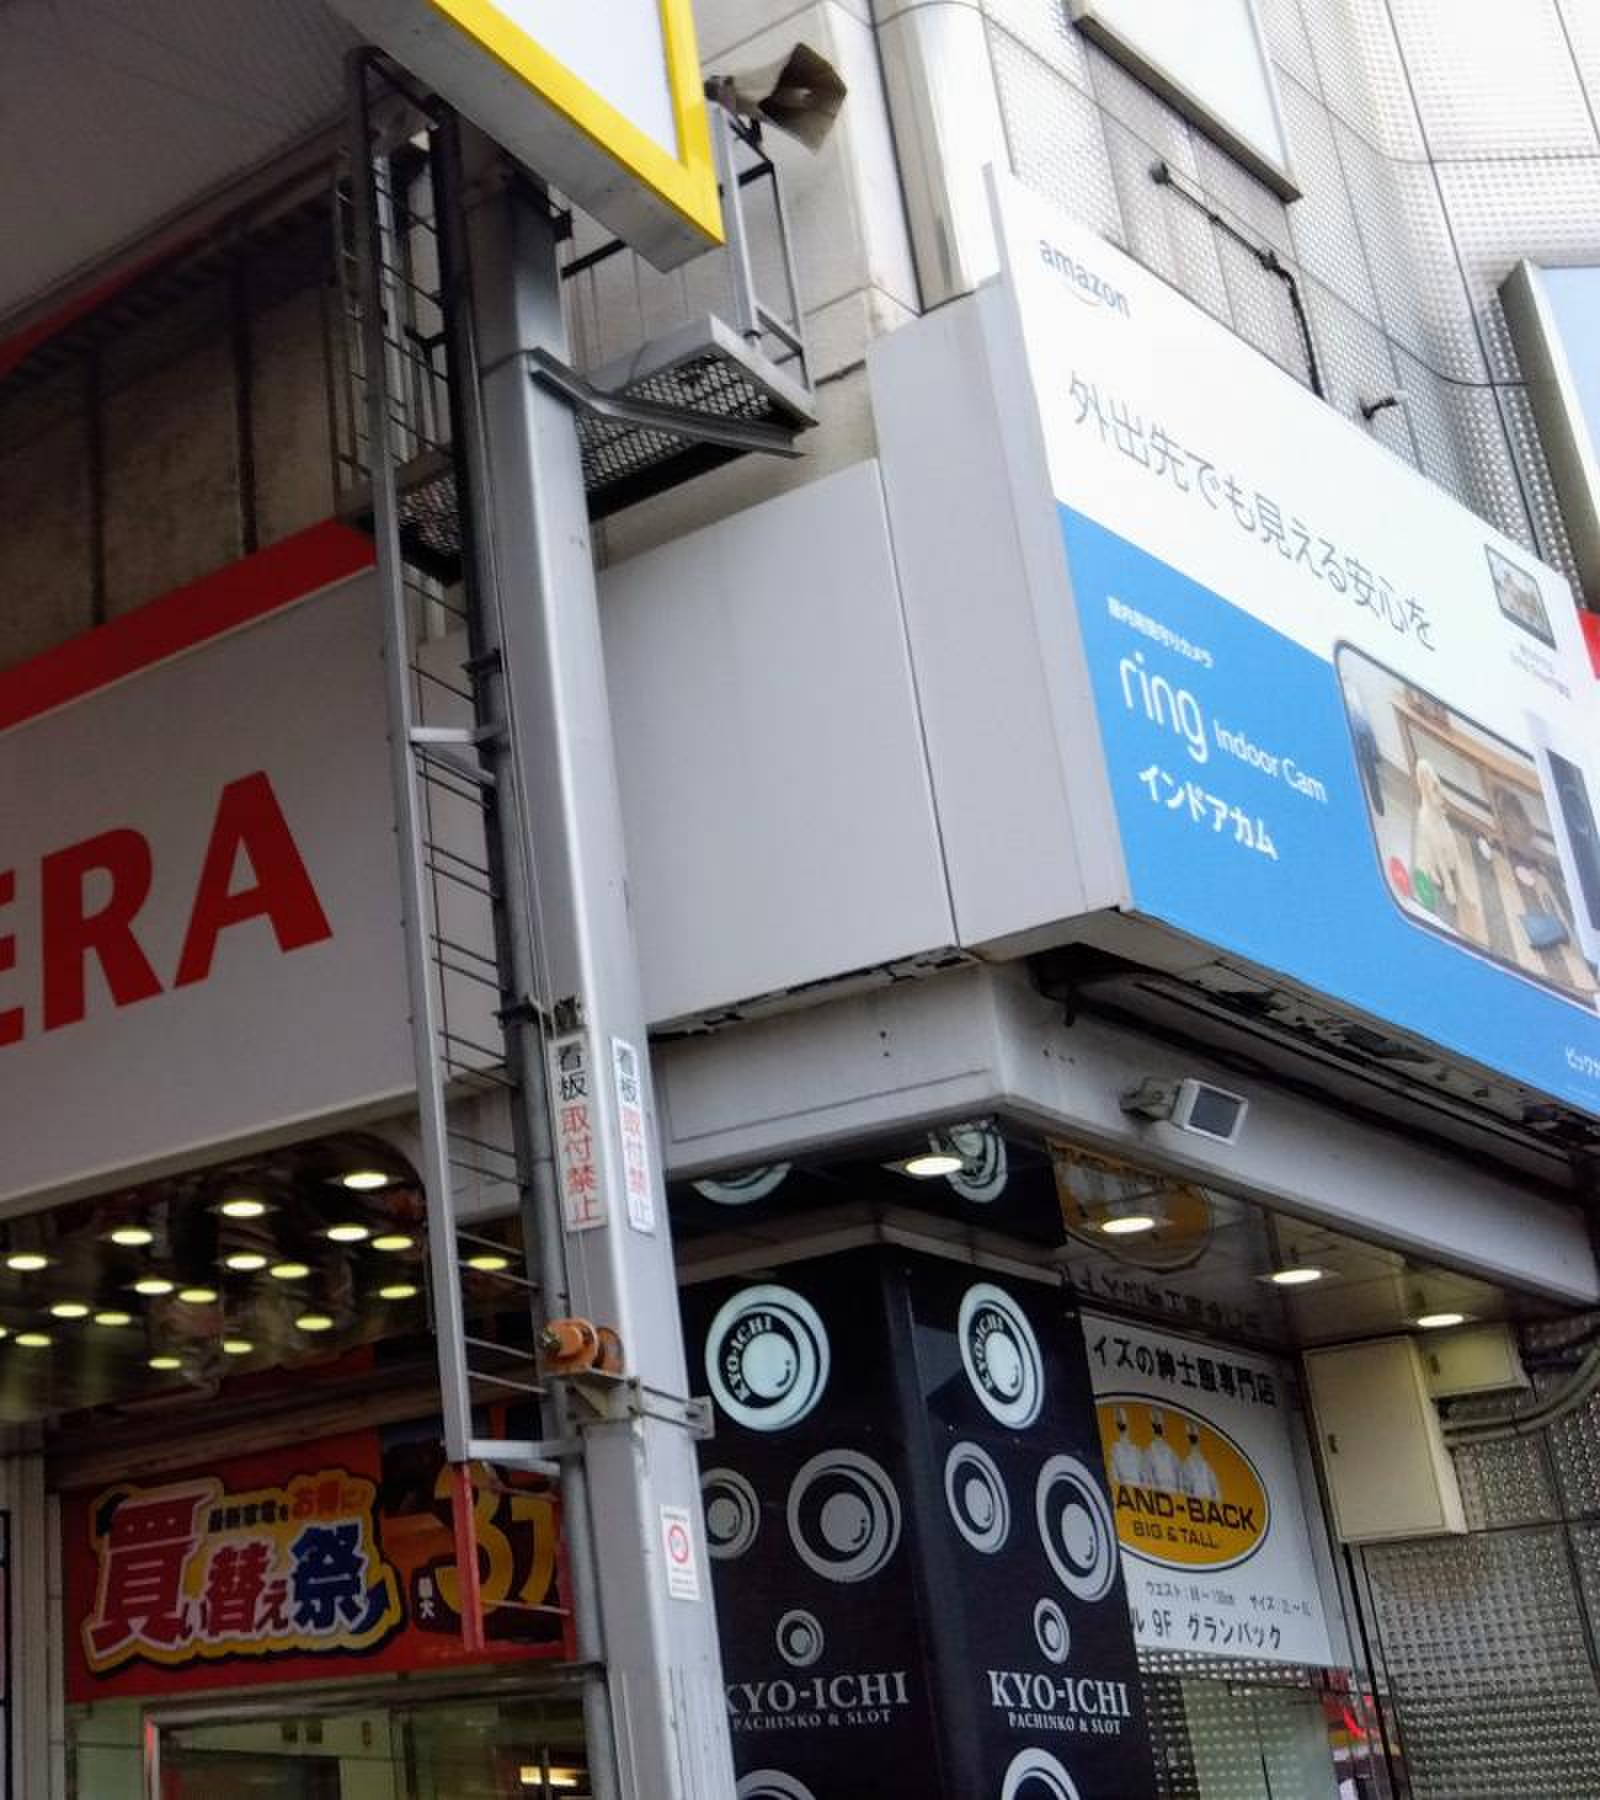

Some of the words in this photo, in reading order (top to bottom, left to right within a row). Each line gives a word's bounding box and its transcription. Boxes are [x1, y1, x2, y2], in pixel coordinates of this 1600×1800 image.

[1039, 239, 1130, 319] amazon
[1068, 371, 1437, 652] 外出先でも見える安心を
[1119, 651, 1208, 764] ring
[1213, 719, 1280, 777] Indoor
[1281, 757, 1329, 804] Cam
[1138, 765, 1279, 861] インドアカム
[1117, 1485, 1257, 1533] AND-BACK
[1134, 1520, 1163, 1539] BIG
[1179, 1527, 1220, 1548] TALL
[1152, 1609, 1172, 1638] 9F
[987, 1670, 1131, 1717] KYO-ICHI
[734, 1712, 821, 1730] PACHINKO
[847, 1708, 892, 1724] SLOT
[1008, 1712, 1075, 1732] PACHINKO
[1091, 1718, 1121, 1735] SLOT
